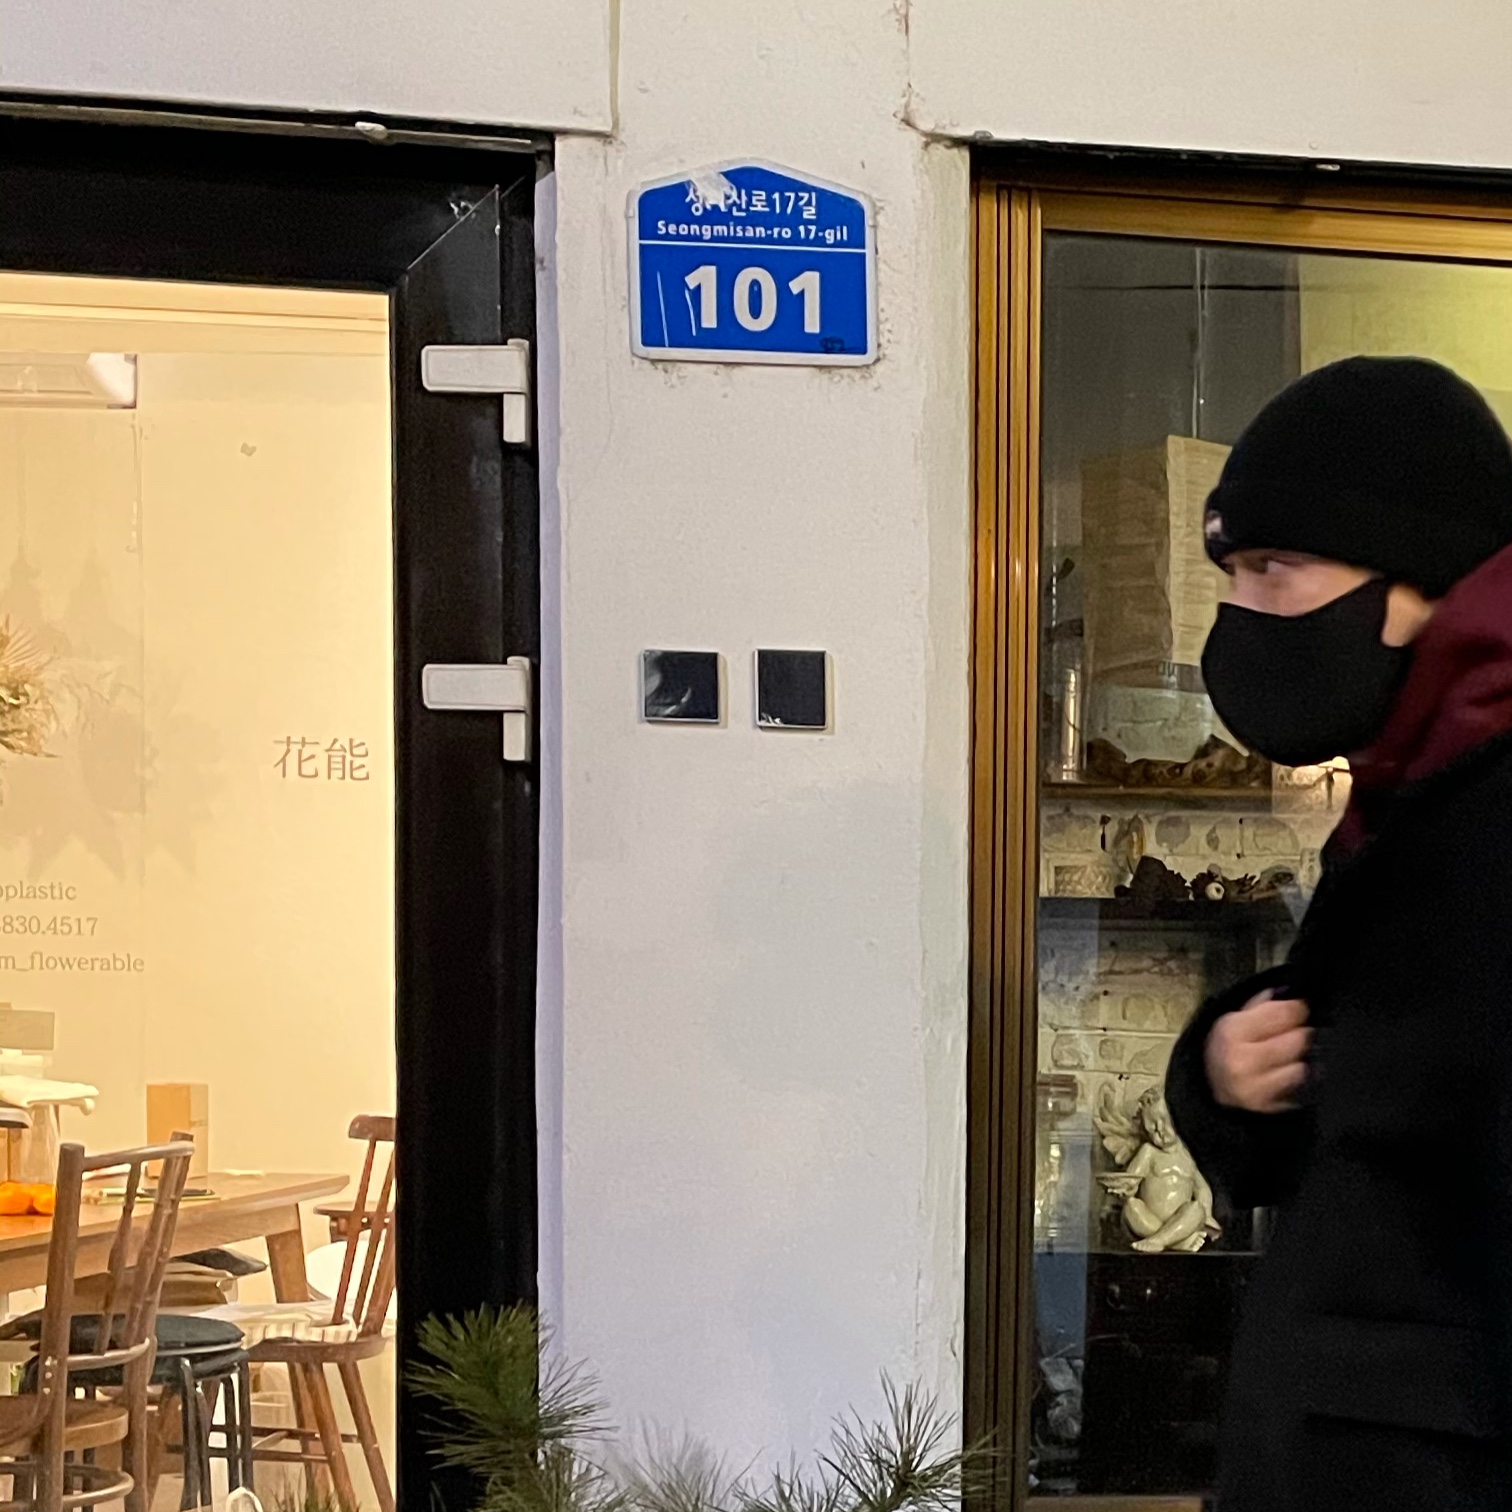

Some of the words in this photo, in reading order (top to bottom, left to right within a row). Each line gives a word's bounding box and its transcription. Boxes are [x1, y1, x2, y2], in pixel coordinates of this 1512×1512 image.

[657, 220, 792, 240] Seongmisan-ro
[798, 225, 848, 244] 17-gil
[684, 265, 821, 334] 101
[272, 735, 370, 782] 花能
[0, 880, 77, 902] plastic
[0, 914, 99, 937] 830.4517
